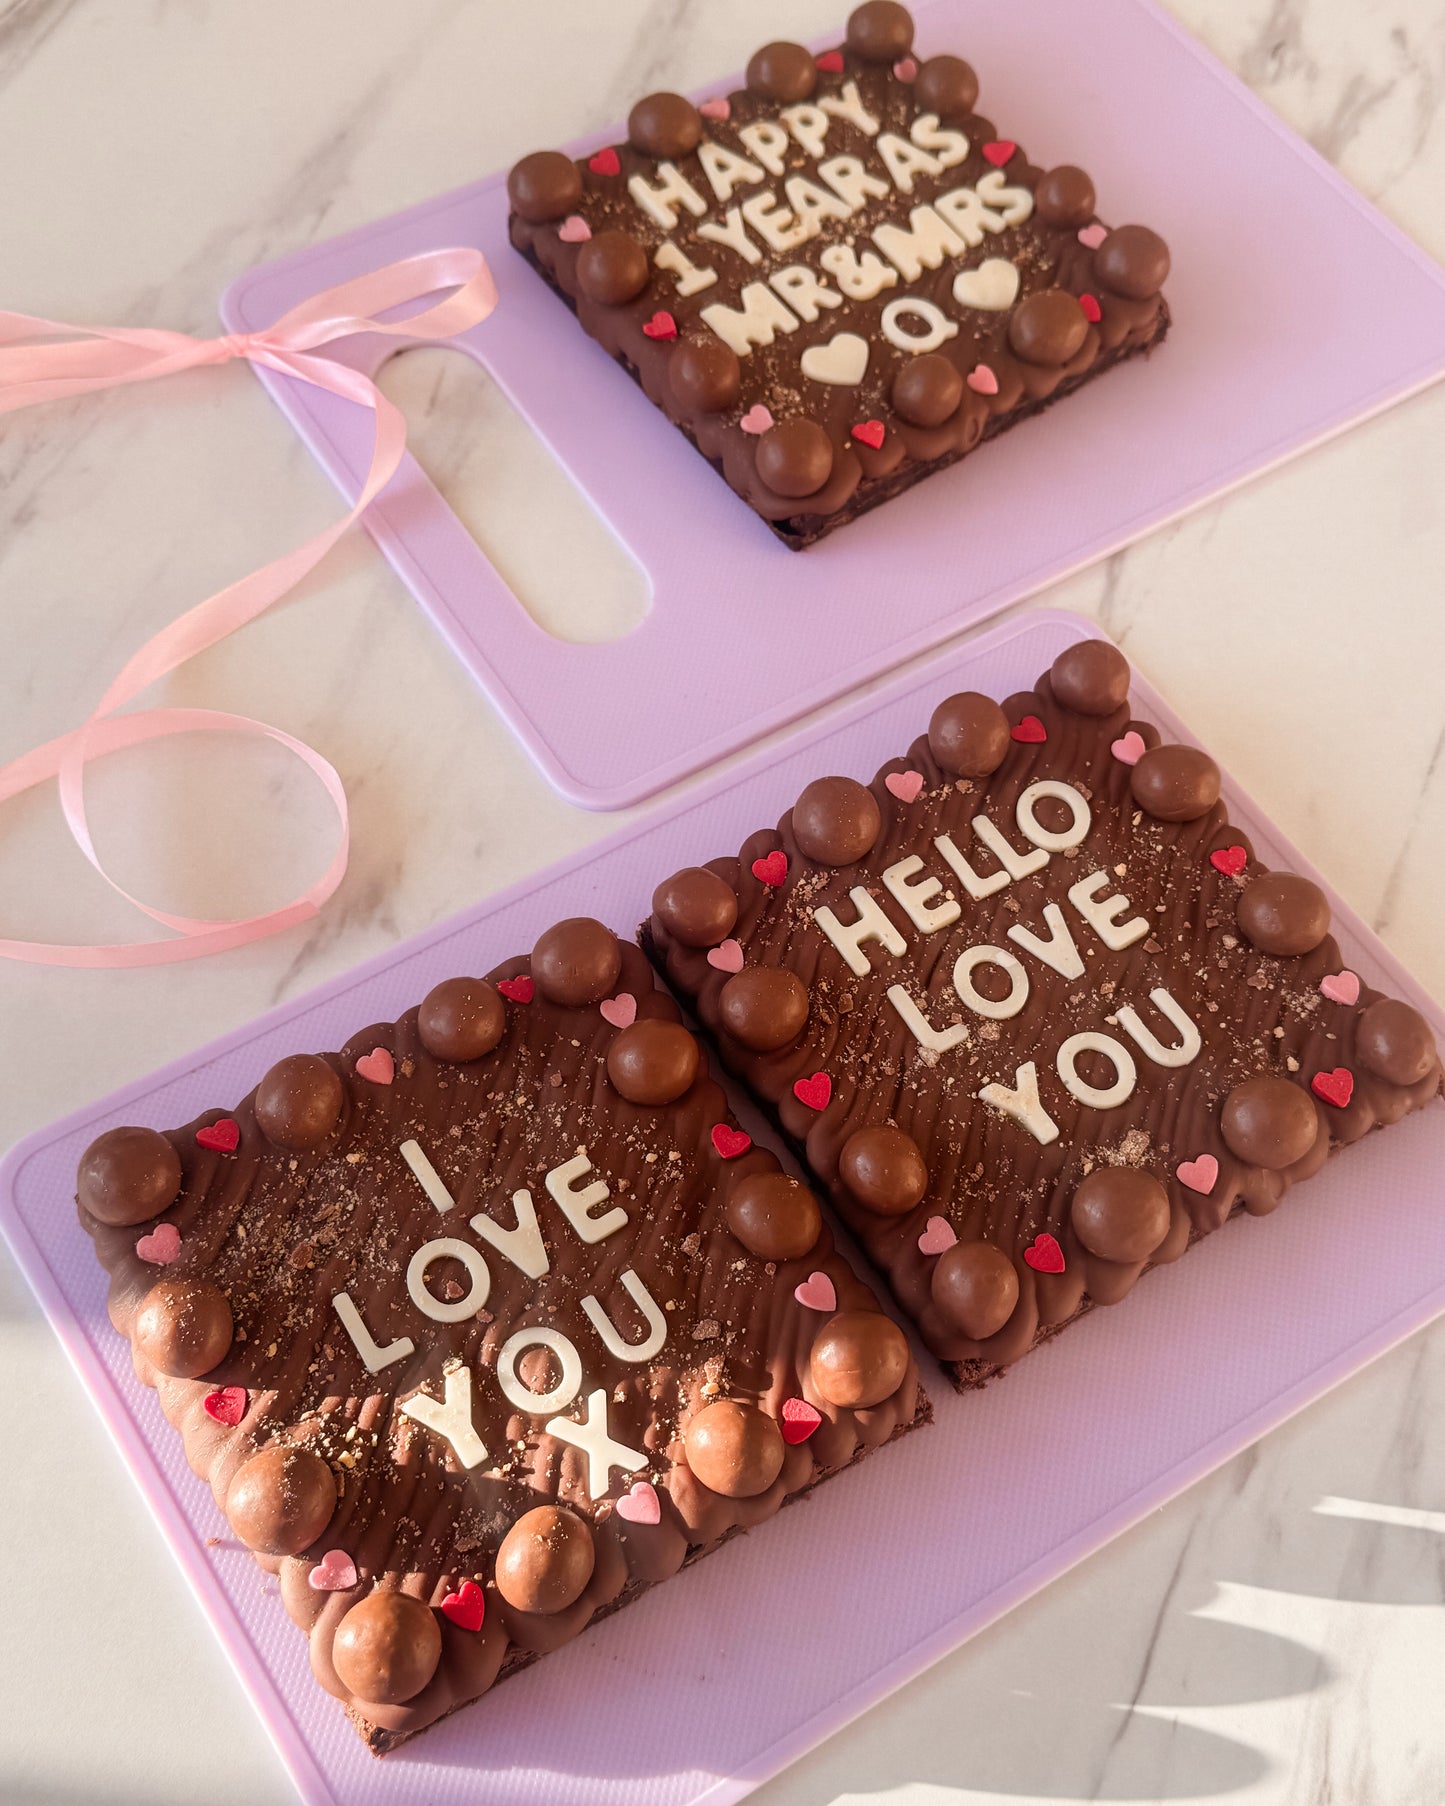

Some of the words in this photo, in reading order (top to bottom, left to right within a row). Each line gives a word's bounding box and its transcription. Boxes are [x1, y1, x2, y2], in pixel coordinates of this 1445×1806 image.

[627, 81, 880, 230] HAPPY
[653, 241, 719, 298] 1
[697, 154, 890, 265] YEAR
[875, 113, 970, 193] AS
[813, 779, 1092, 977] HELLO
[886, 870, 1150, 1054] LOVE
[977, 987, 1202, 1146] YOU
[332, 1153, 629, 1374] LOVE
[399, 1139, 456, 1215] I
[401, 1269, 668, 1470] YOU
[545, 1388, 650, 1501] X
